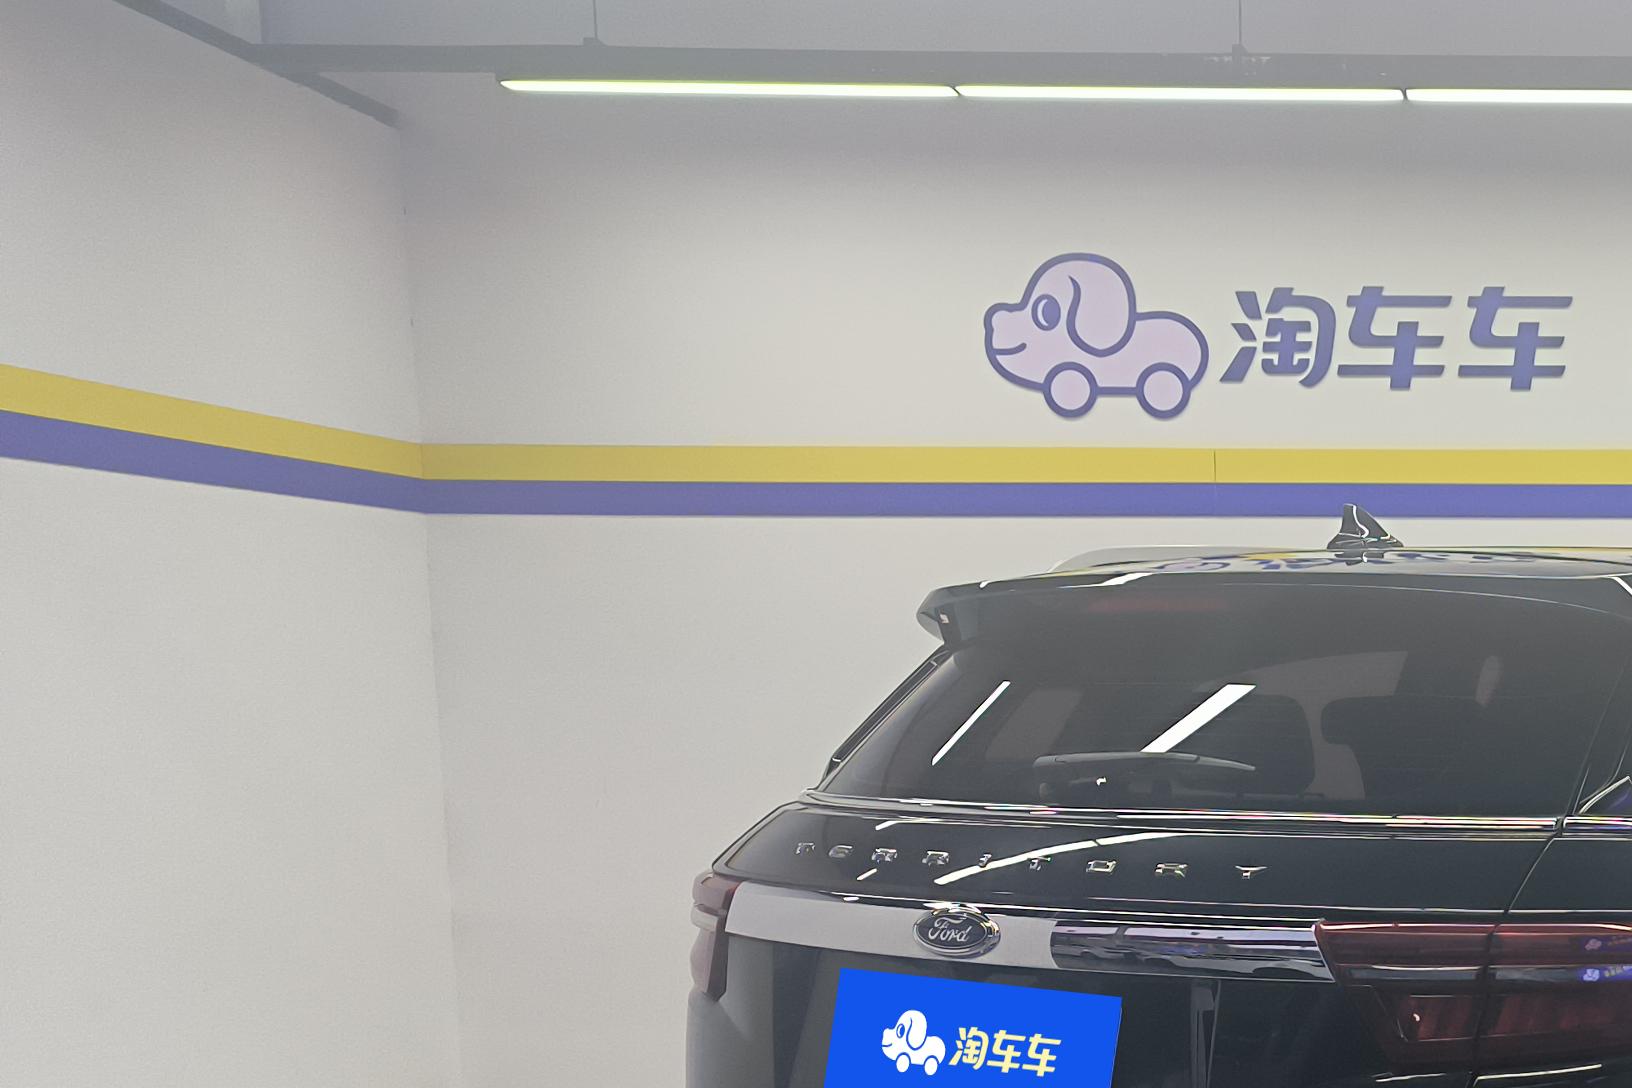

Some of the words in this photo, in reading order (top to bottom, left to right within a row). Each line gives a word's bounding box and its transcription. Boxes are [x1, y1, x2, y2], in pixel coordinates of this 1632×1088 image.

[1219, 286, 1573, 391] 淘车车
[927, 916, 973, 943] Ford
